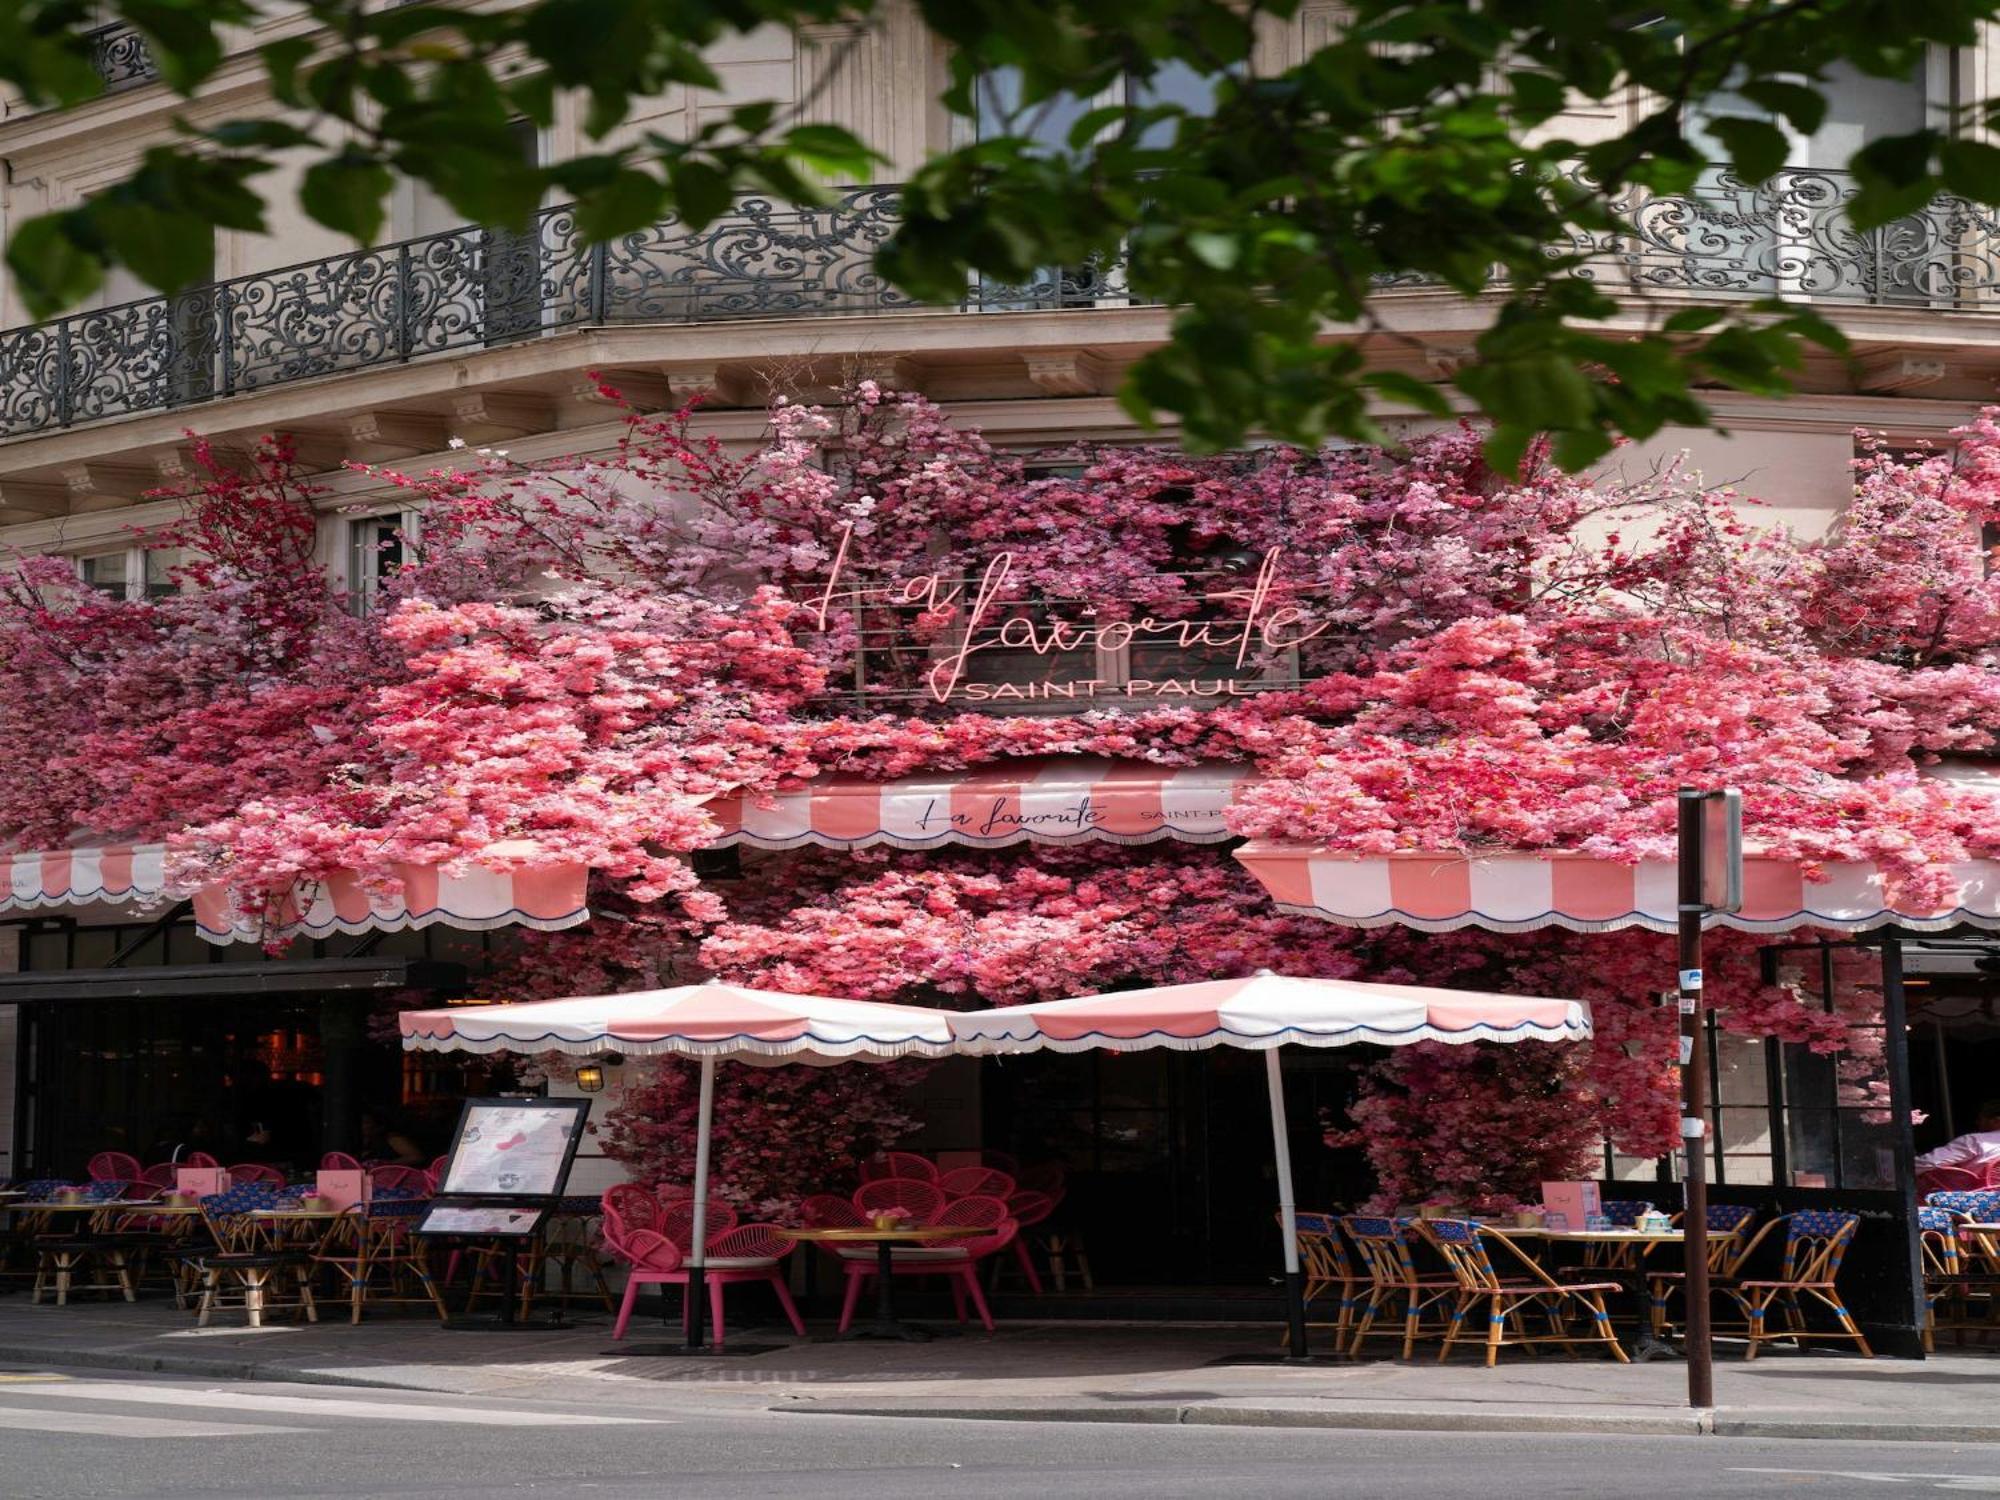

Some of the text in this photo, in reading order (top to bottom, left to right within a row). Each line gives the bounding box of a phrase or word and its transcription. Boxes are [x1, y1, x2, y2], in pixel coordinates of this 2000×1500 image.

[928, 546, 1331, 703] favorite
[965, 678, 1255, 700] SAINT PAUL
[915, 799, 972, 830] La
[1140, 810, 1222, 819] SAINT-P
